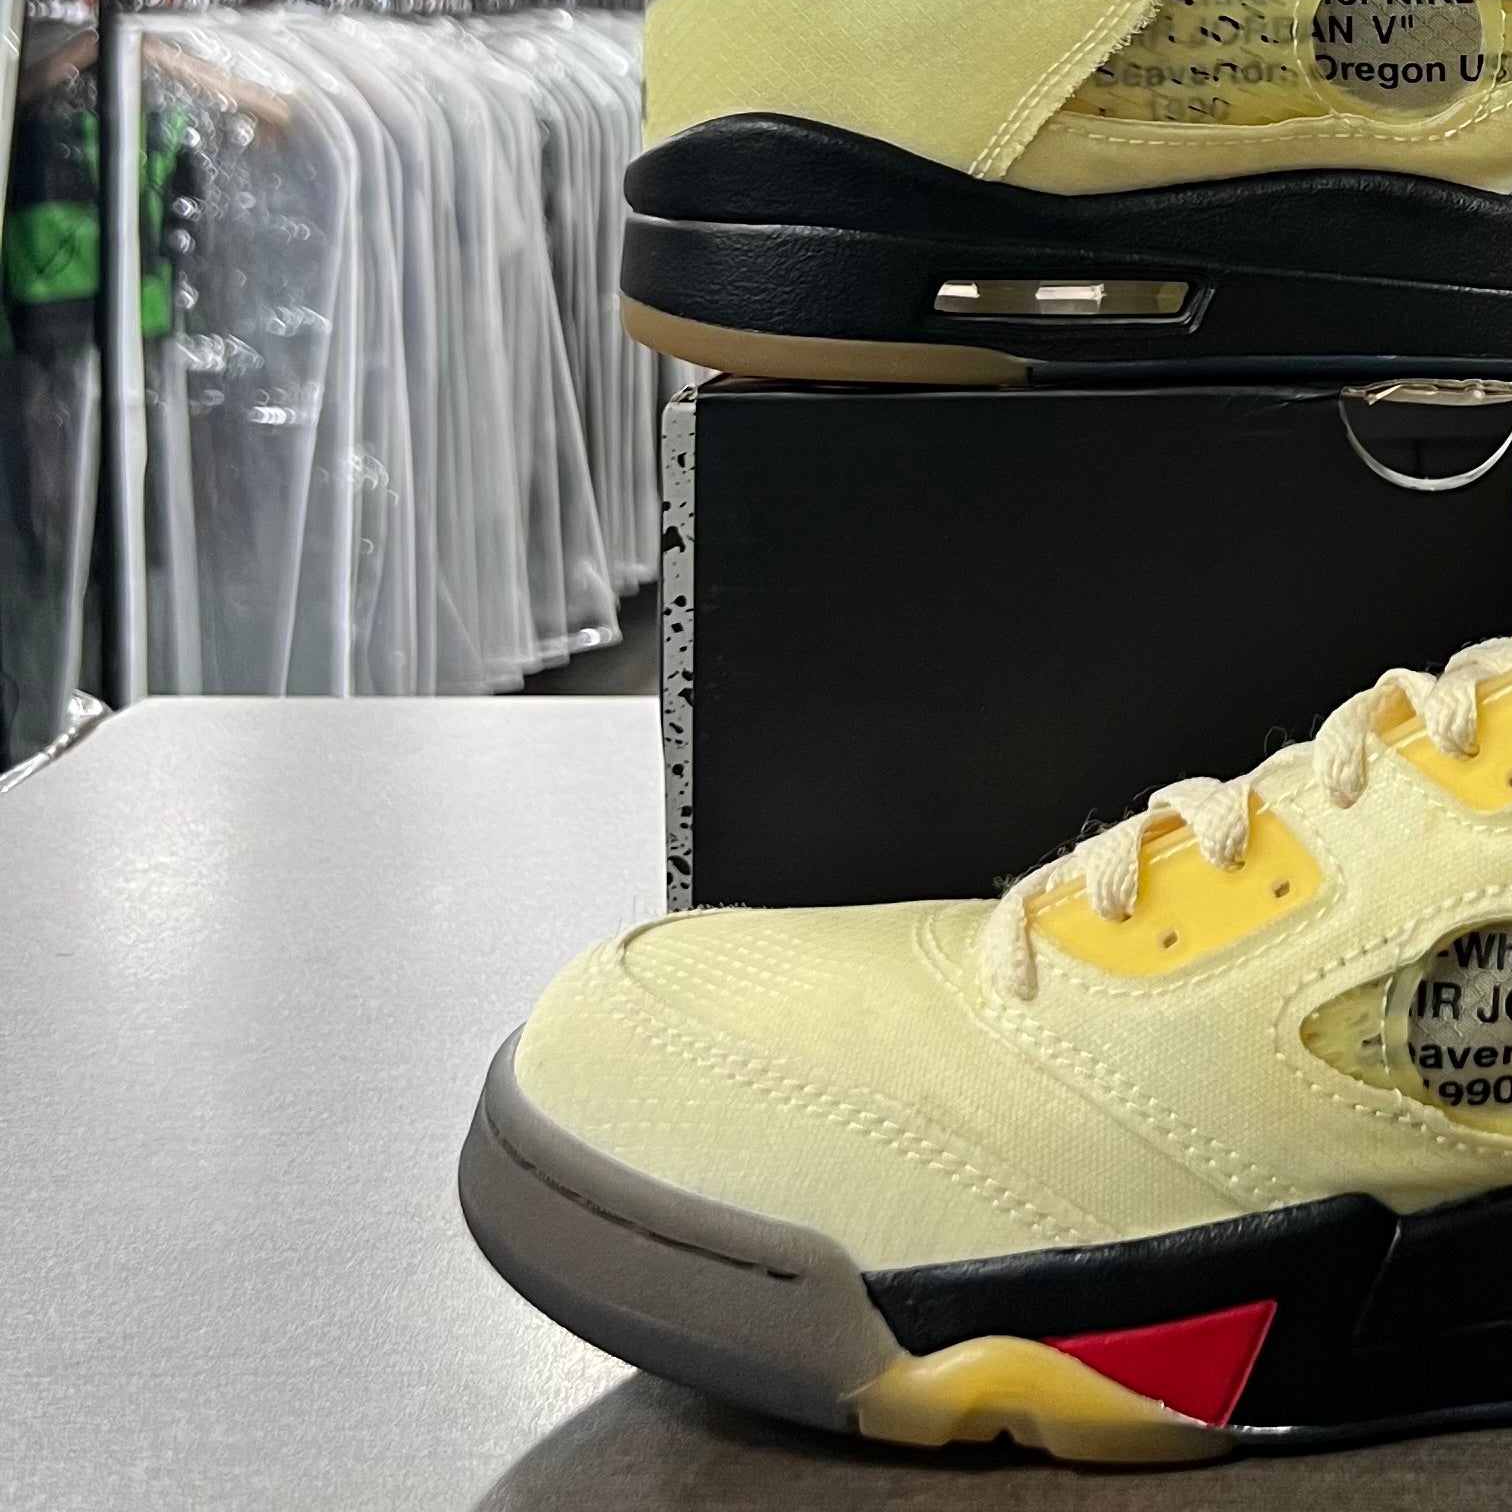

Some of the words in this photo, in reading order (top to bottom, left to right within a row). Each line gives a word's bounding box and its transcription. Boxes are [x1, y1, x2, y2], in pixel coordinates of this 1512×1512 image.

[1372, 14, 1414, 45] V"
[1314, 54, 1446, 90] Oregon
[1409, 981, 1462, 1020] IR
